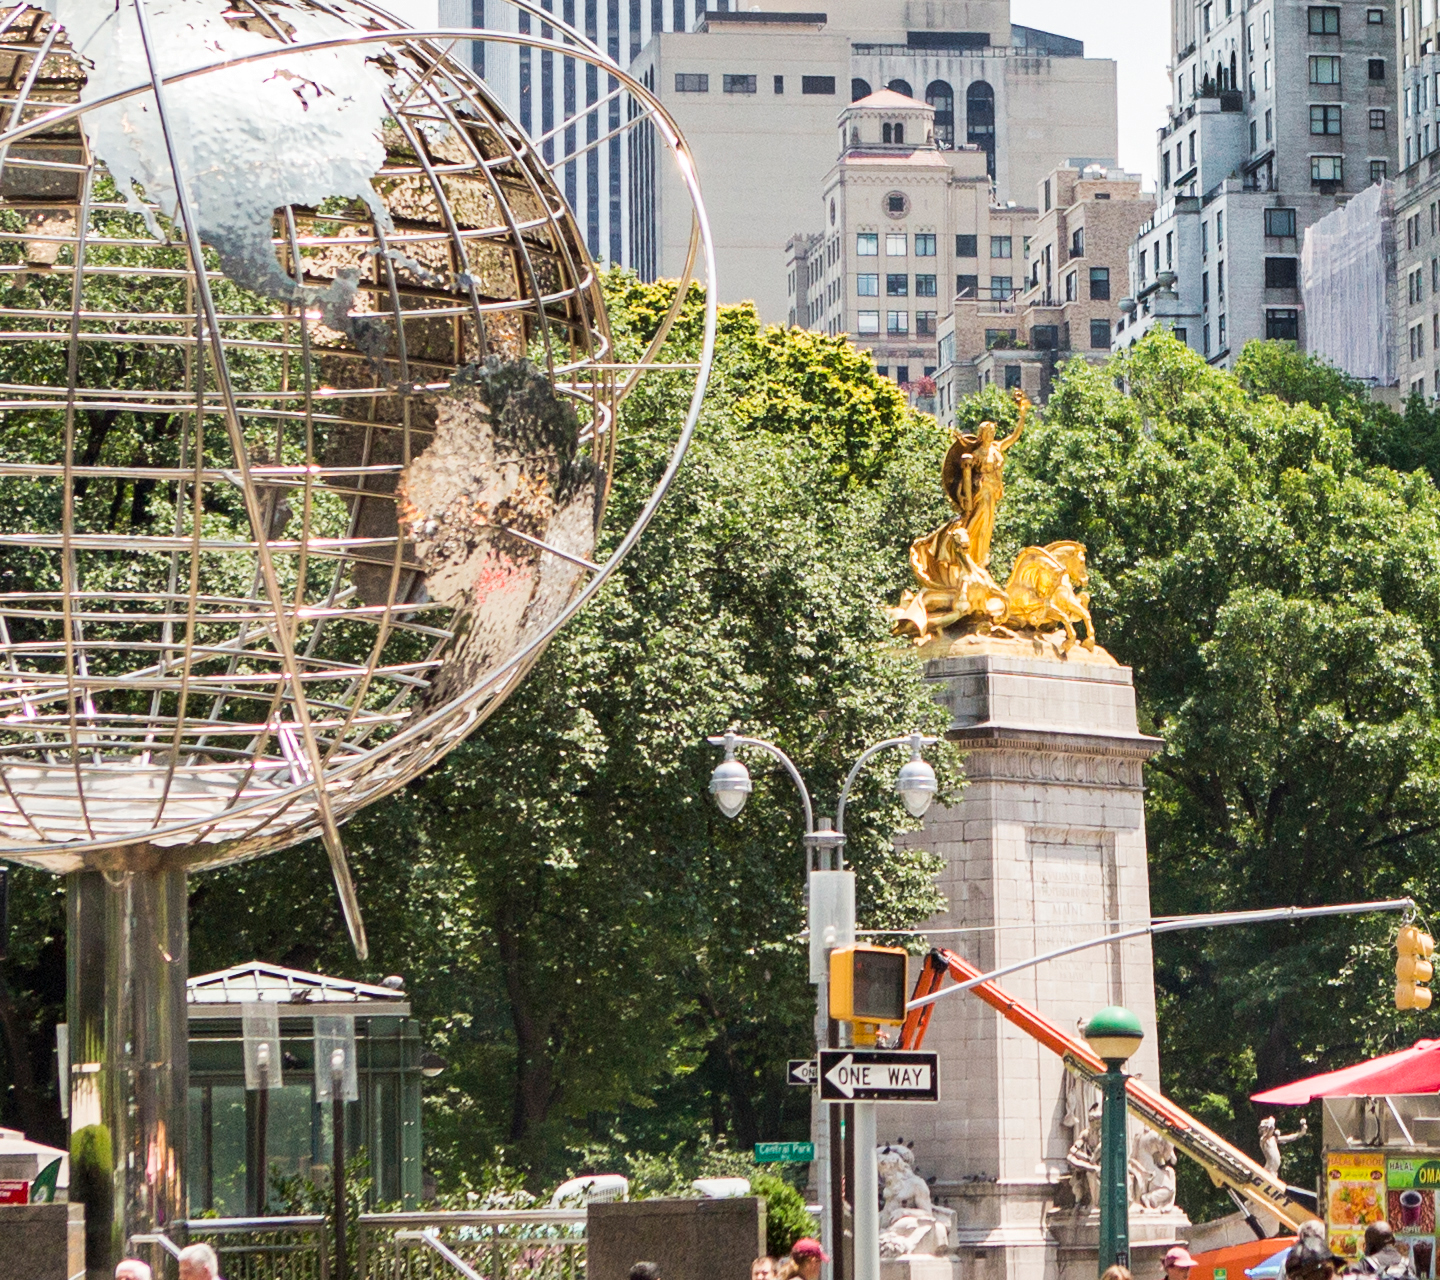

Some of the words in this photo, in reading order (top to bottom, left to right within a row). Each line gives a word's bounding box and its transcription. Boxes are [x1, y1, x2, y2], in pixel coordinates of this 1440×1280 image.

[837, 1066, 872, 1086] ONE
[888, 1067, 923, 1087] WAY
[760, 1144, 791, 1155] Central
[792, 1143, 812, 1154] Park
[1389, 1161, 1414, 1171] HALAL
[1263, 1184, 1294, 1208] LIFT
